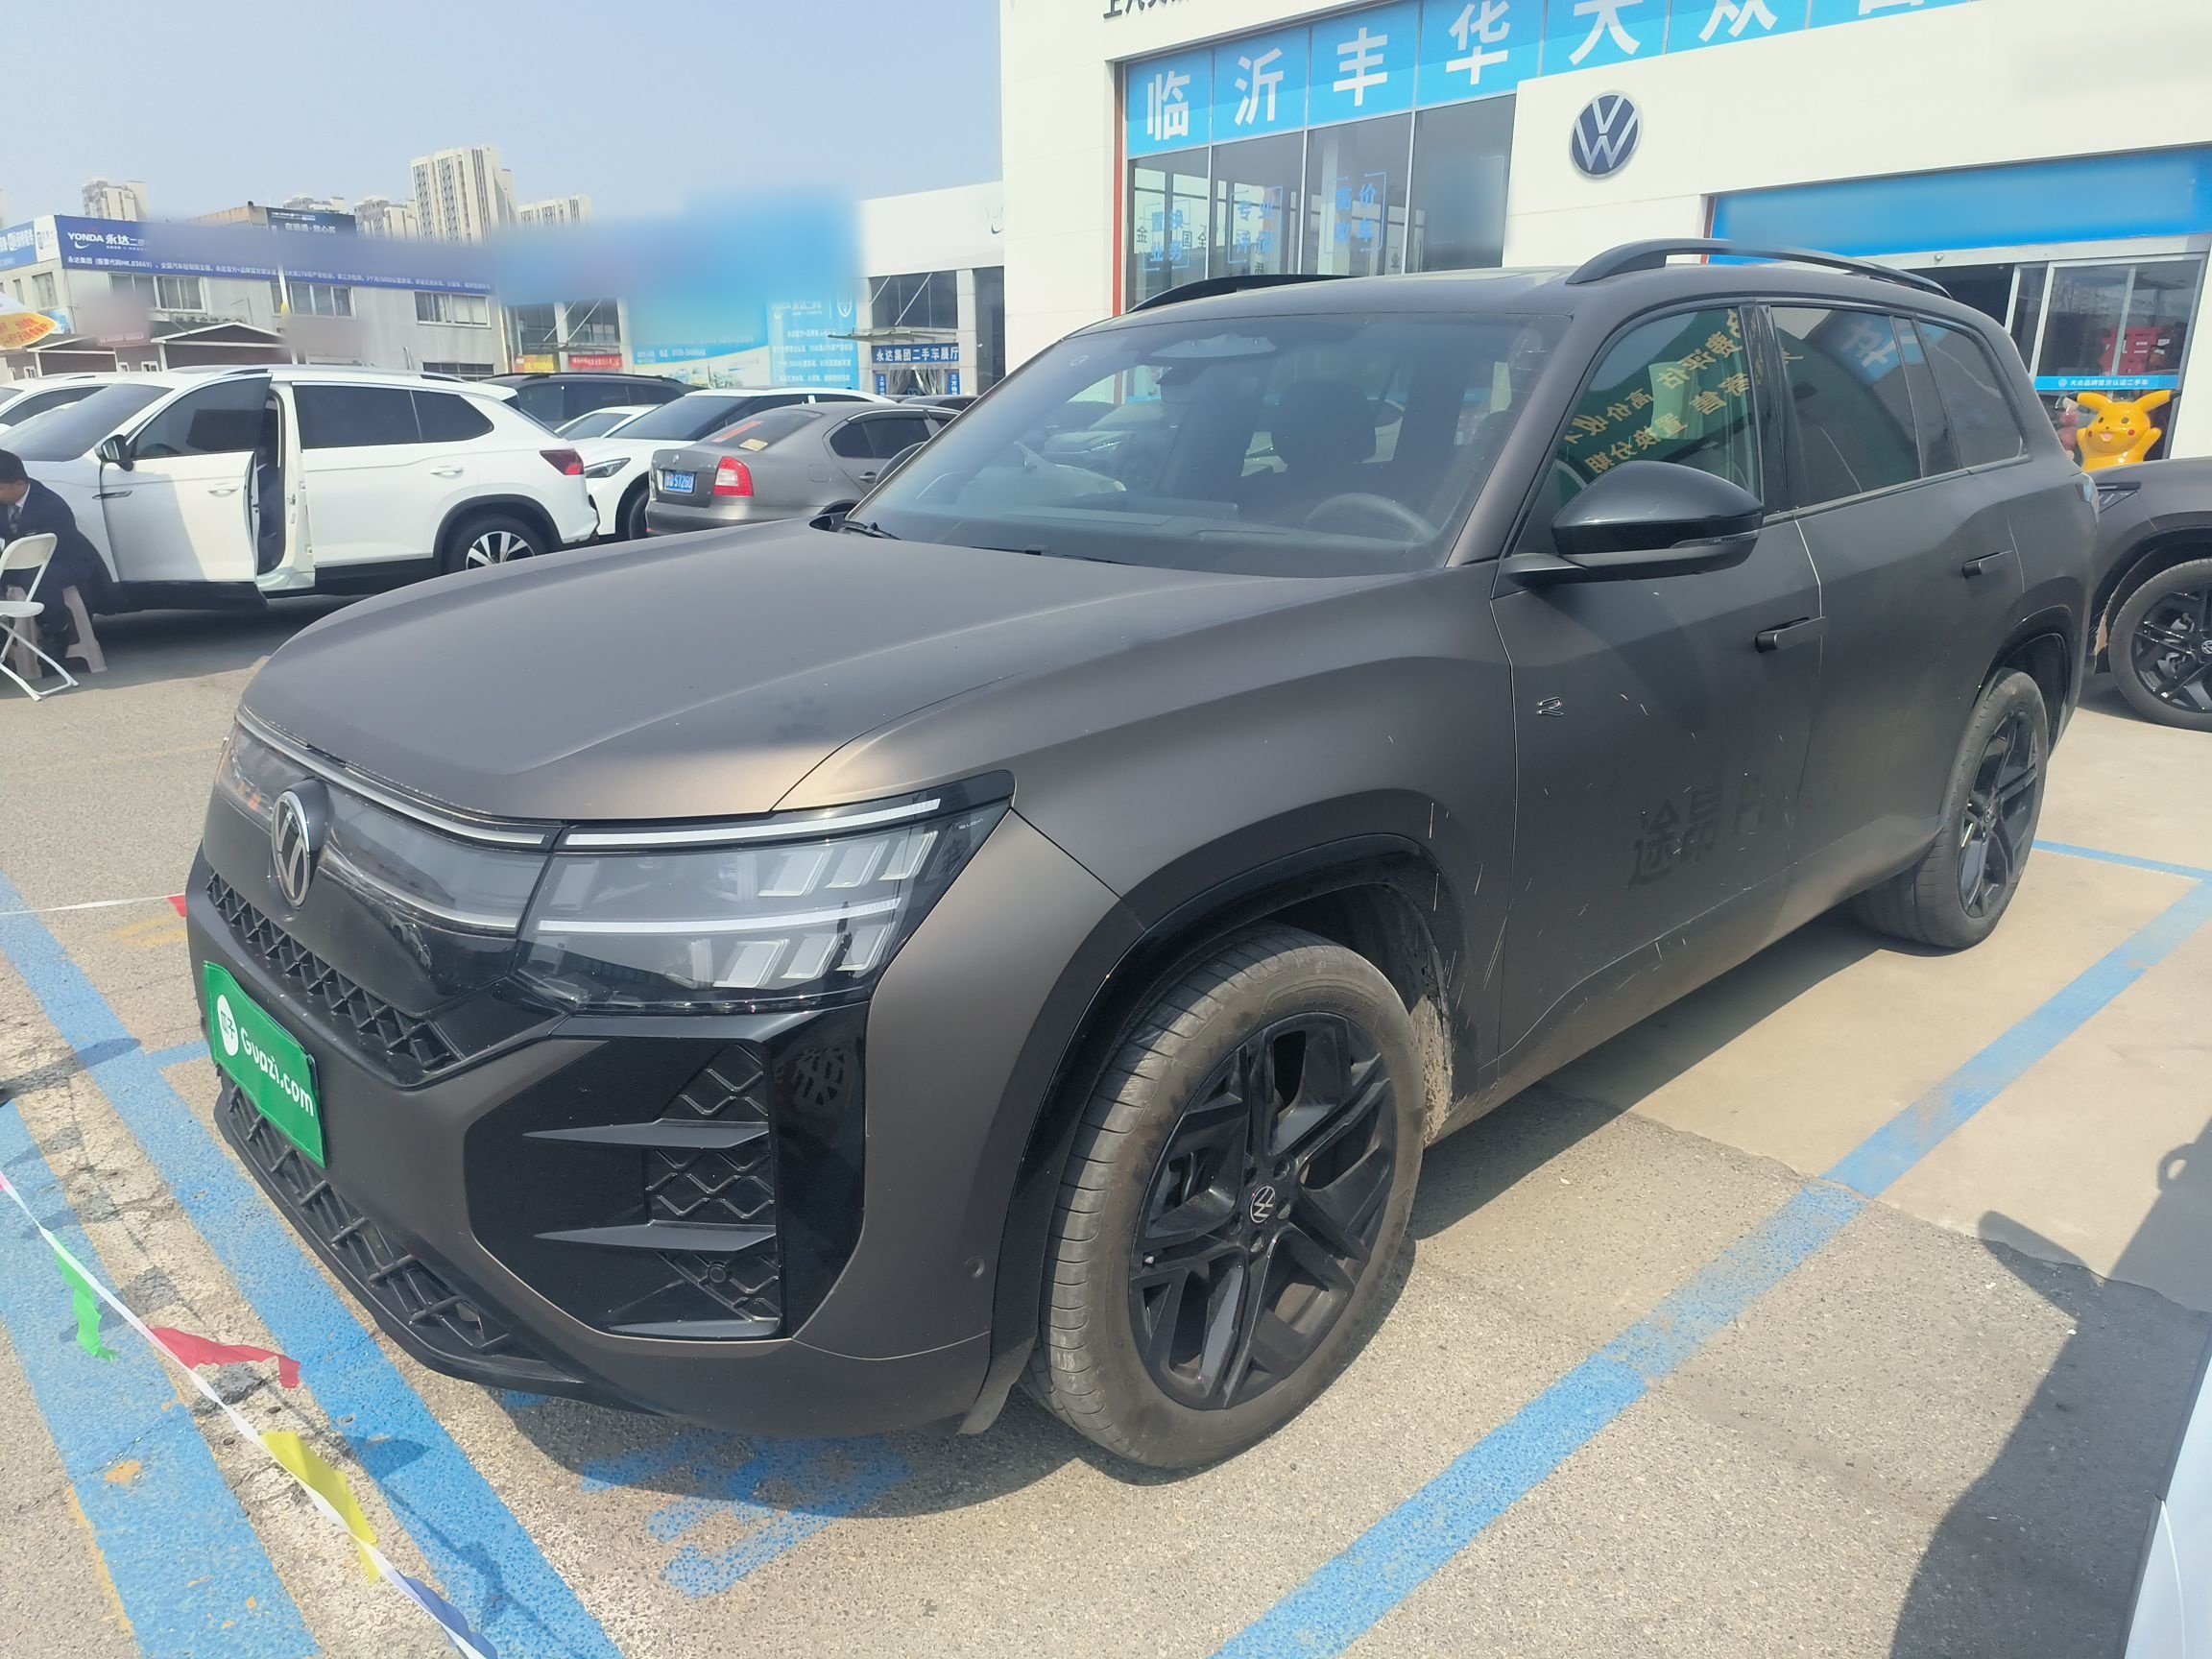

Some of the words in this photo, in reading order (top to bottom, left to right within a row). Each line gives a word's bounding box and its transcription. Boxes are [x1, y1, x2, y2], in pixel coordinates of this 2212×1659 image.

[67, 232, 105, 243] YONDA
[876, 346, 959, 362] 永达集团二手车展厅
[240, 1026, 315, 1118] Guazi.com
